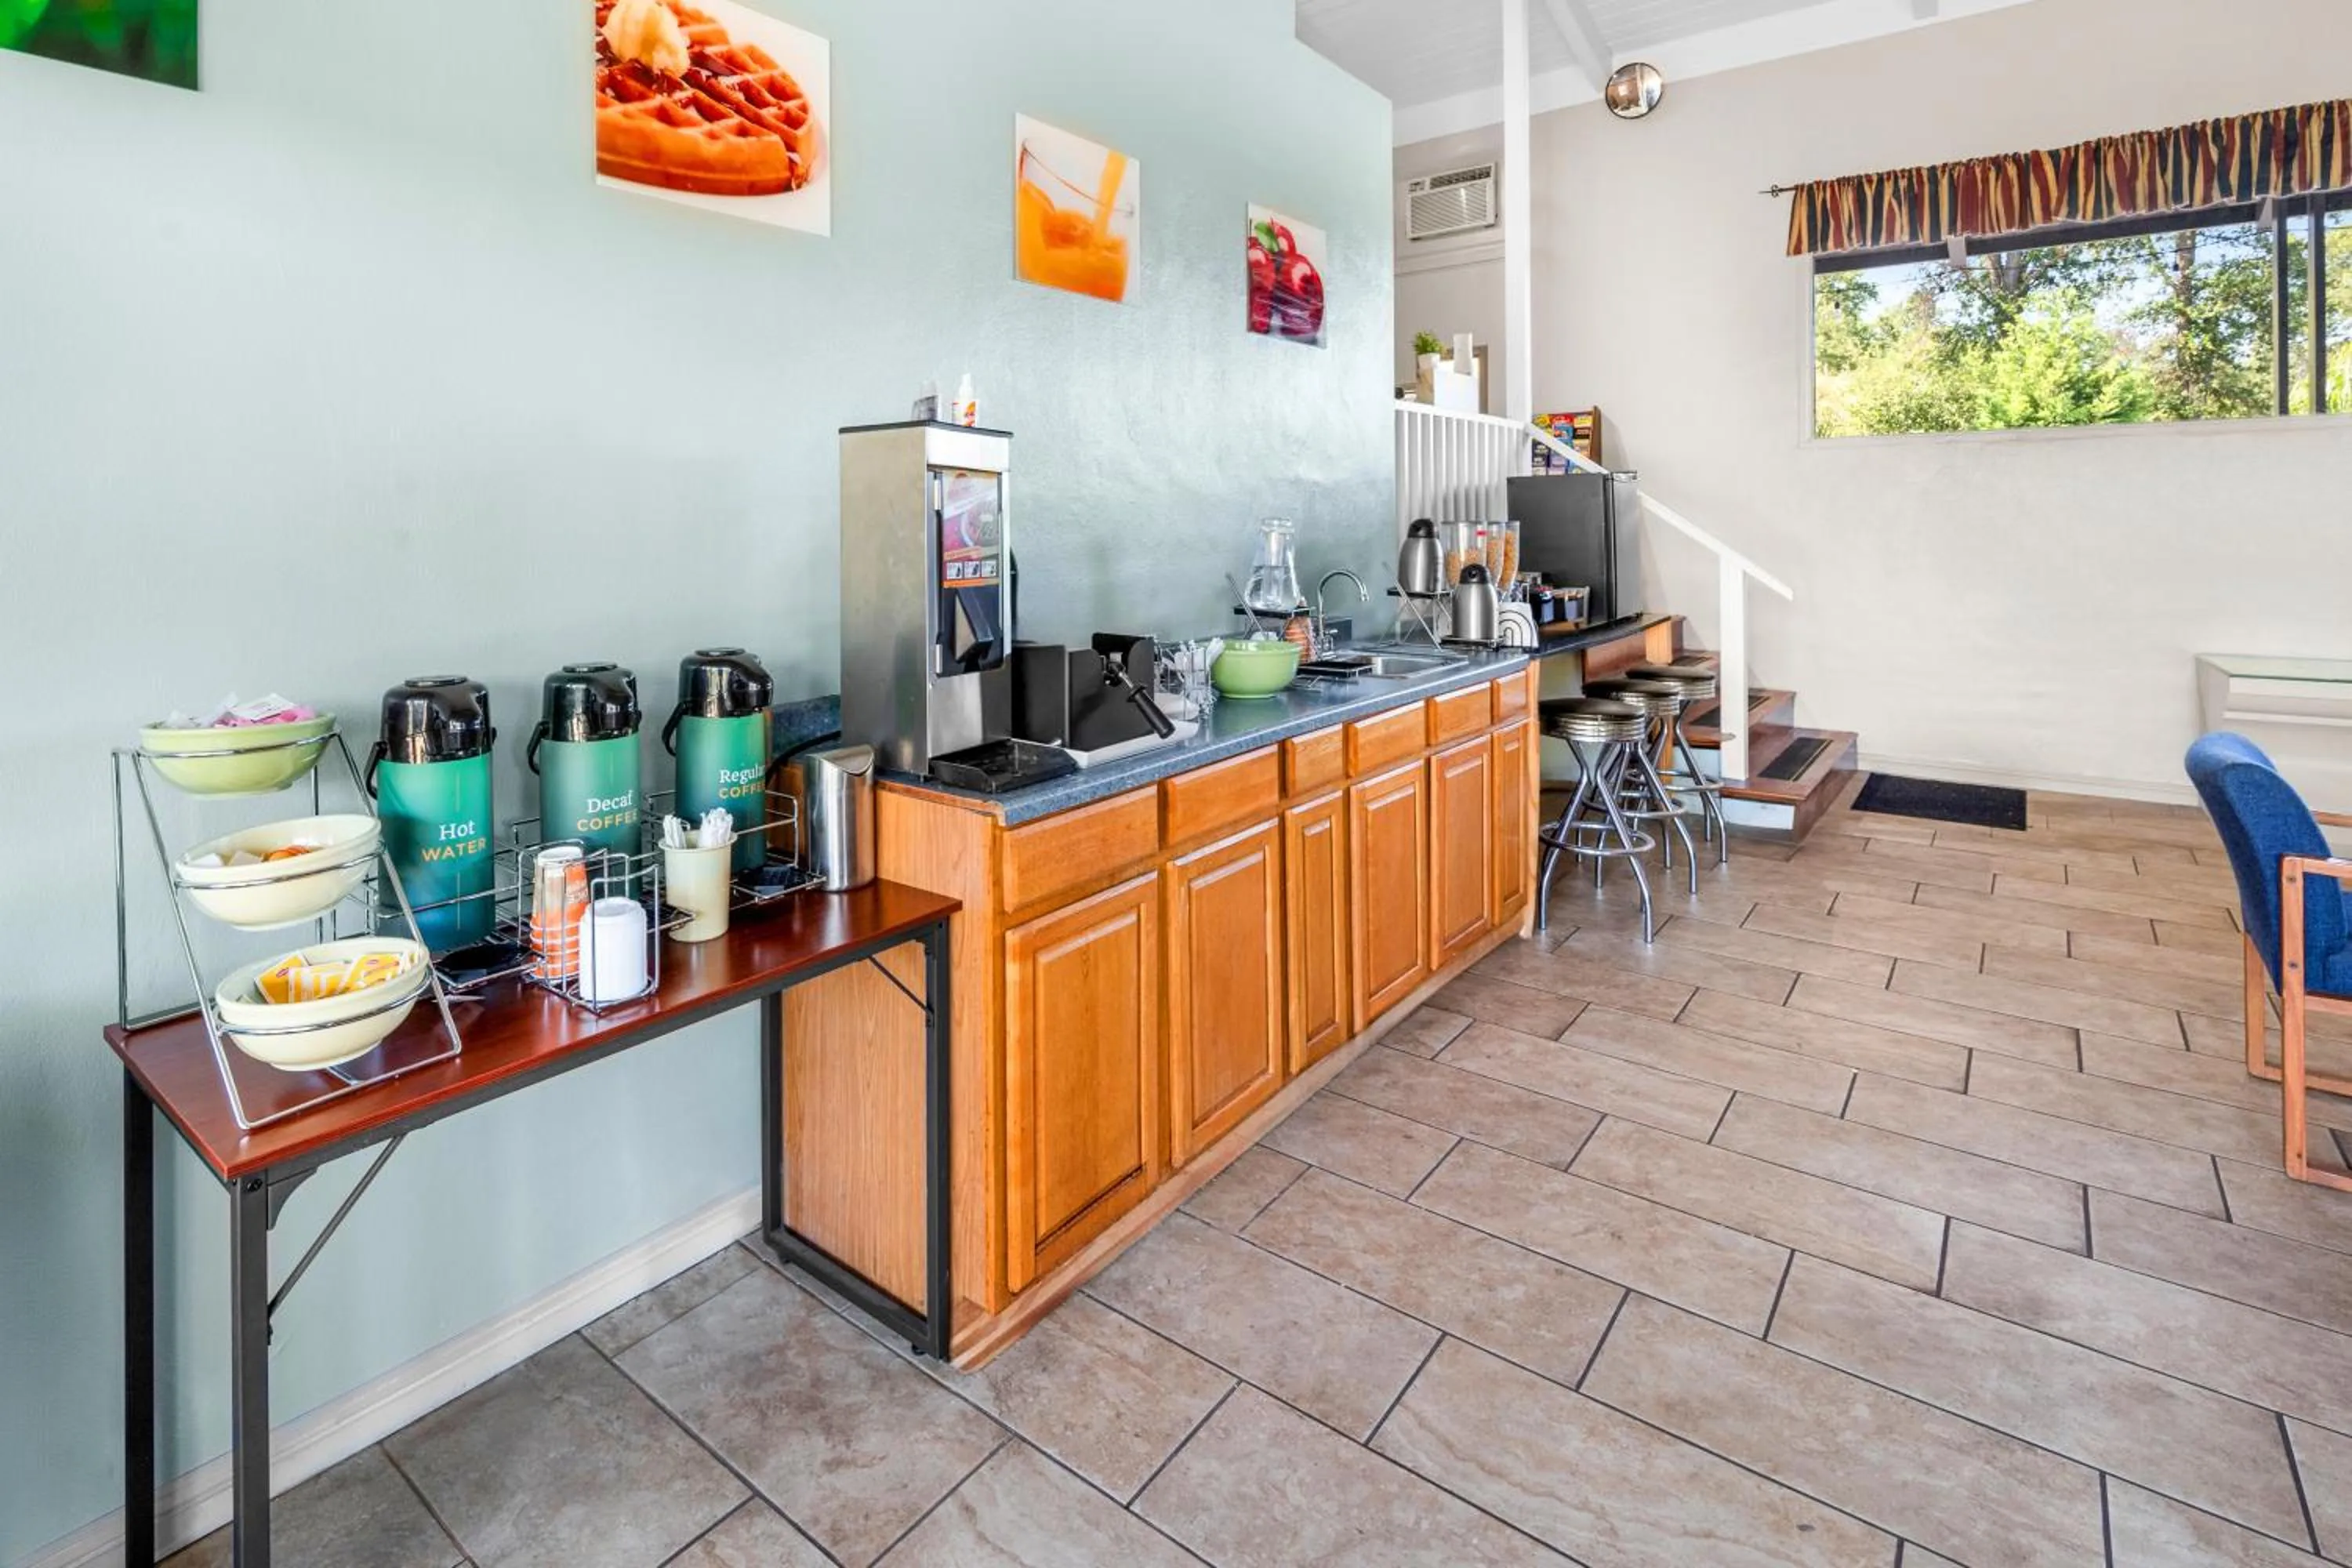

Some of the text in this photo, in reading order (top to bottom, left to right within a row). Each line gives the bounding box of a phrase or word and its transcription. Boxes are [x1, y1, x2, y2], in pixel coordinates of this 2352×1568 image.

[586, 789, 634, 814] Decaf
[439, 819, 476, 841] Hot
[422, 837, 486, 862] WATER
